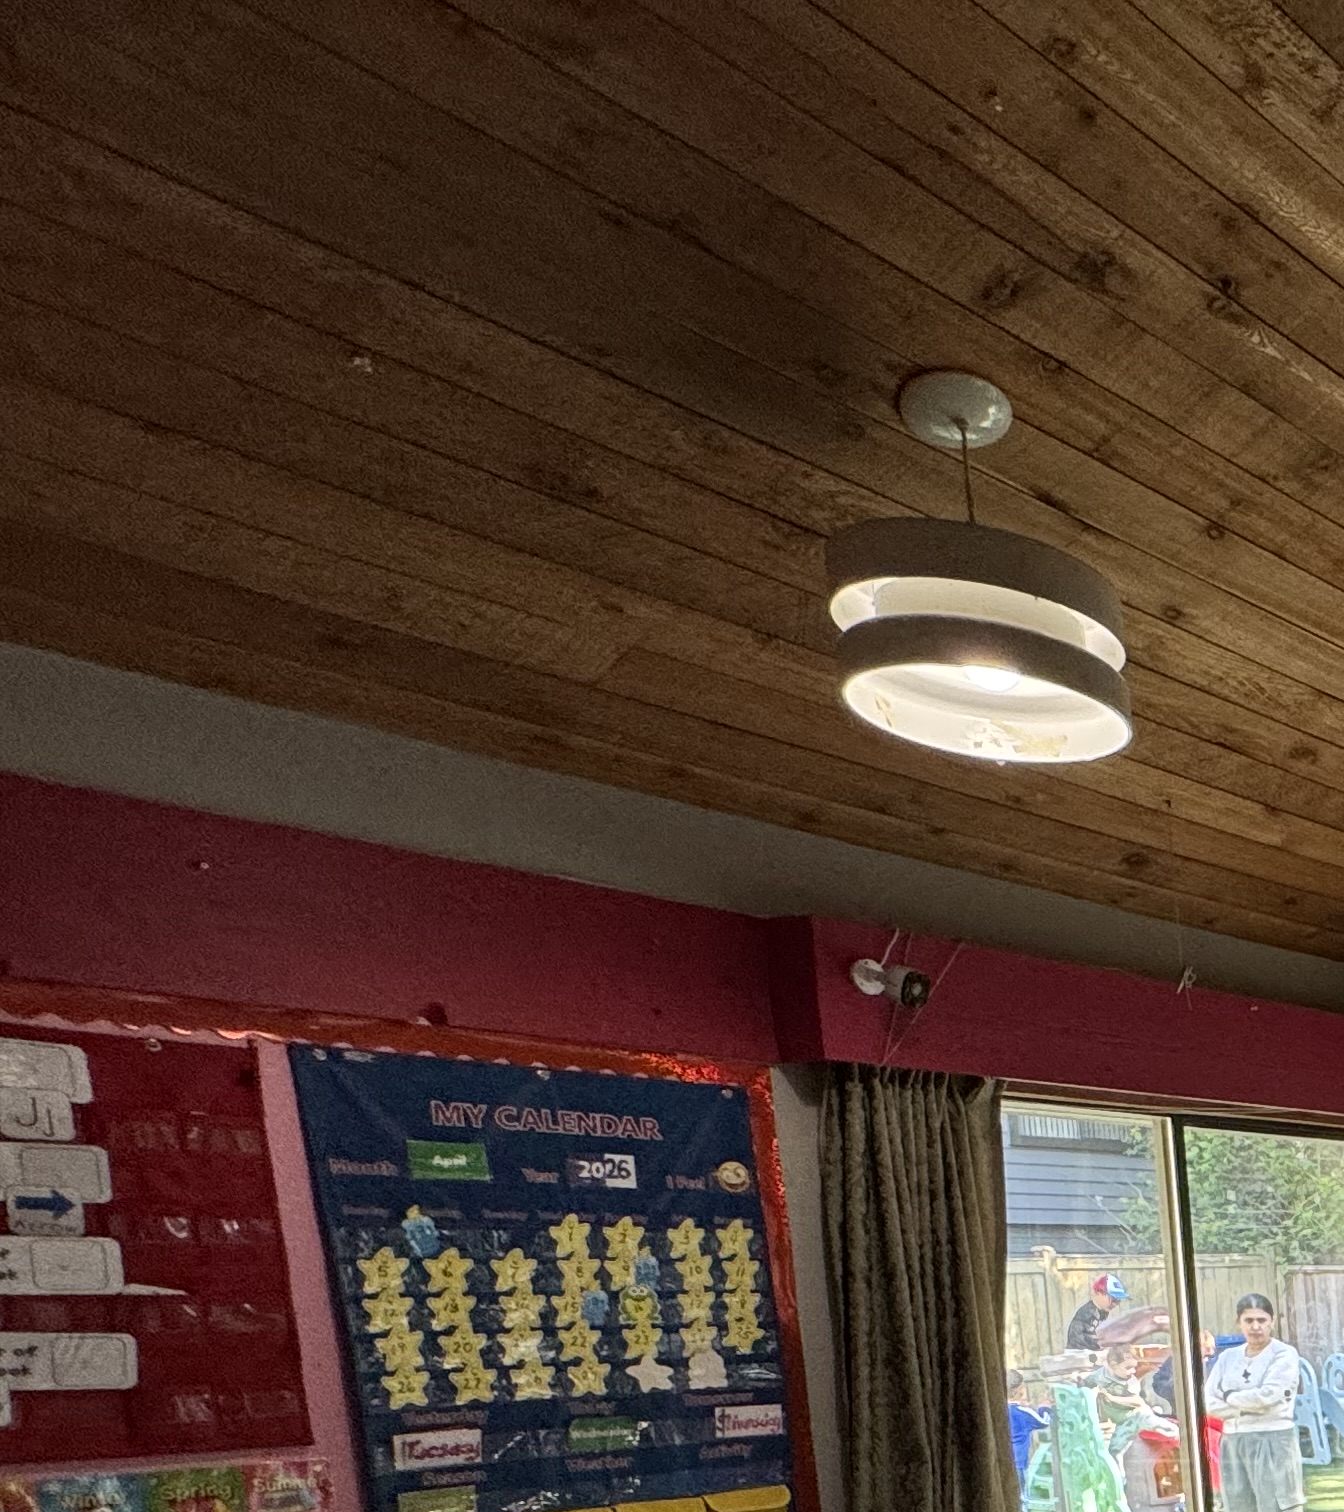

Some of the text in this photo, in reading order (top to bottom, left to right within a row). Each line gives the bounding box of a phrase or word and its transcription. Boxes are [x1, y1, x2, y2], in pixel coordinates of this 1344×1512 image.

[430, 1100, 664, 1140] MY CALENDAR
[377, 1265, 388, 1277] 5
[161, 1483, 234, 1500] Spring
